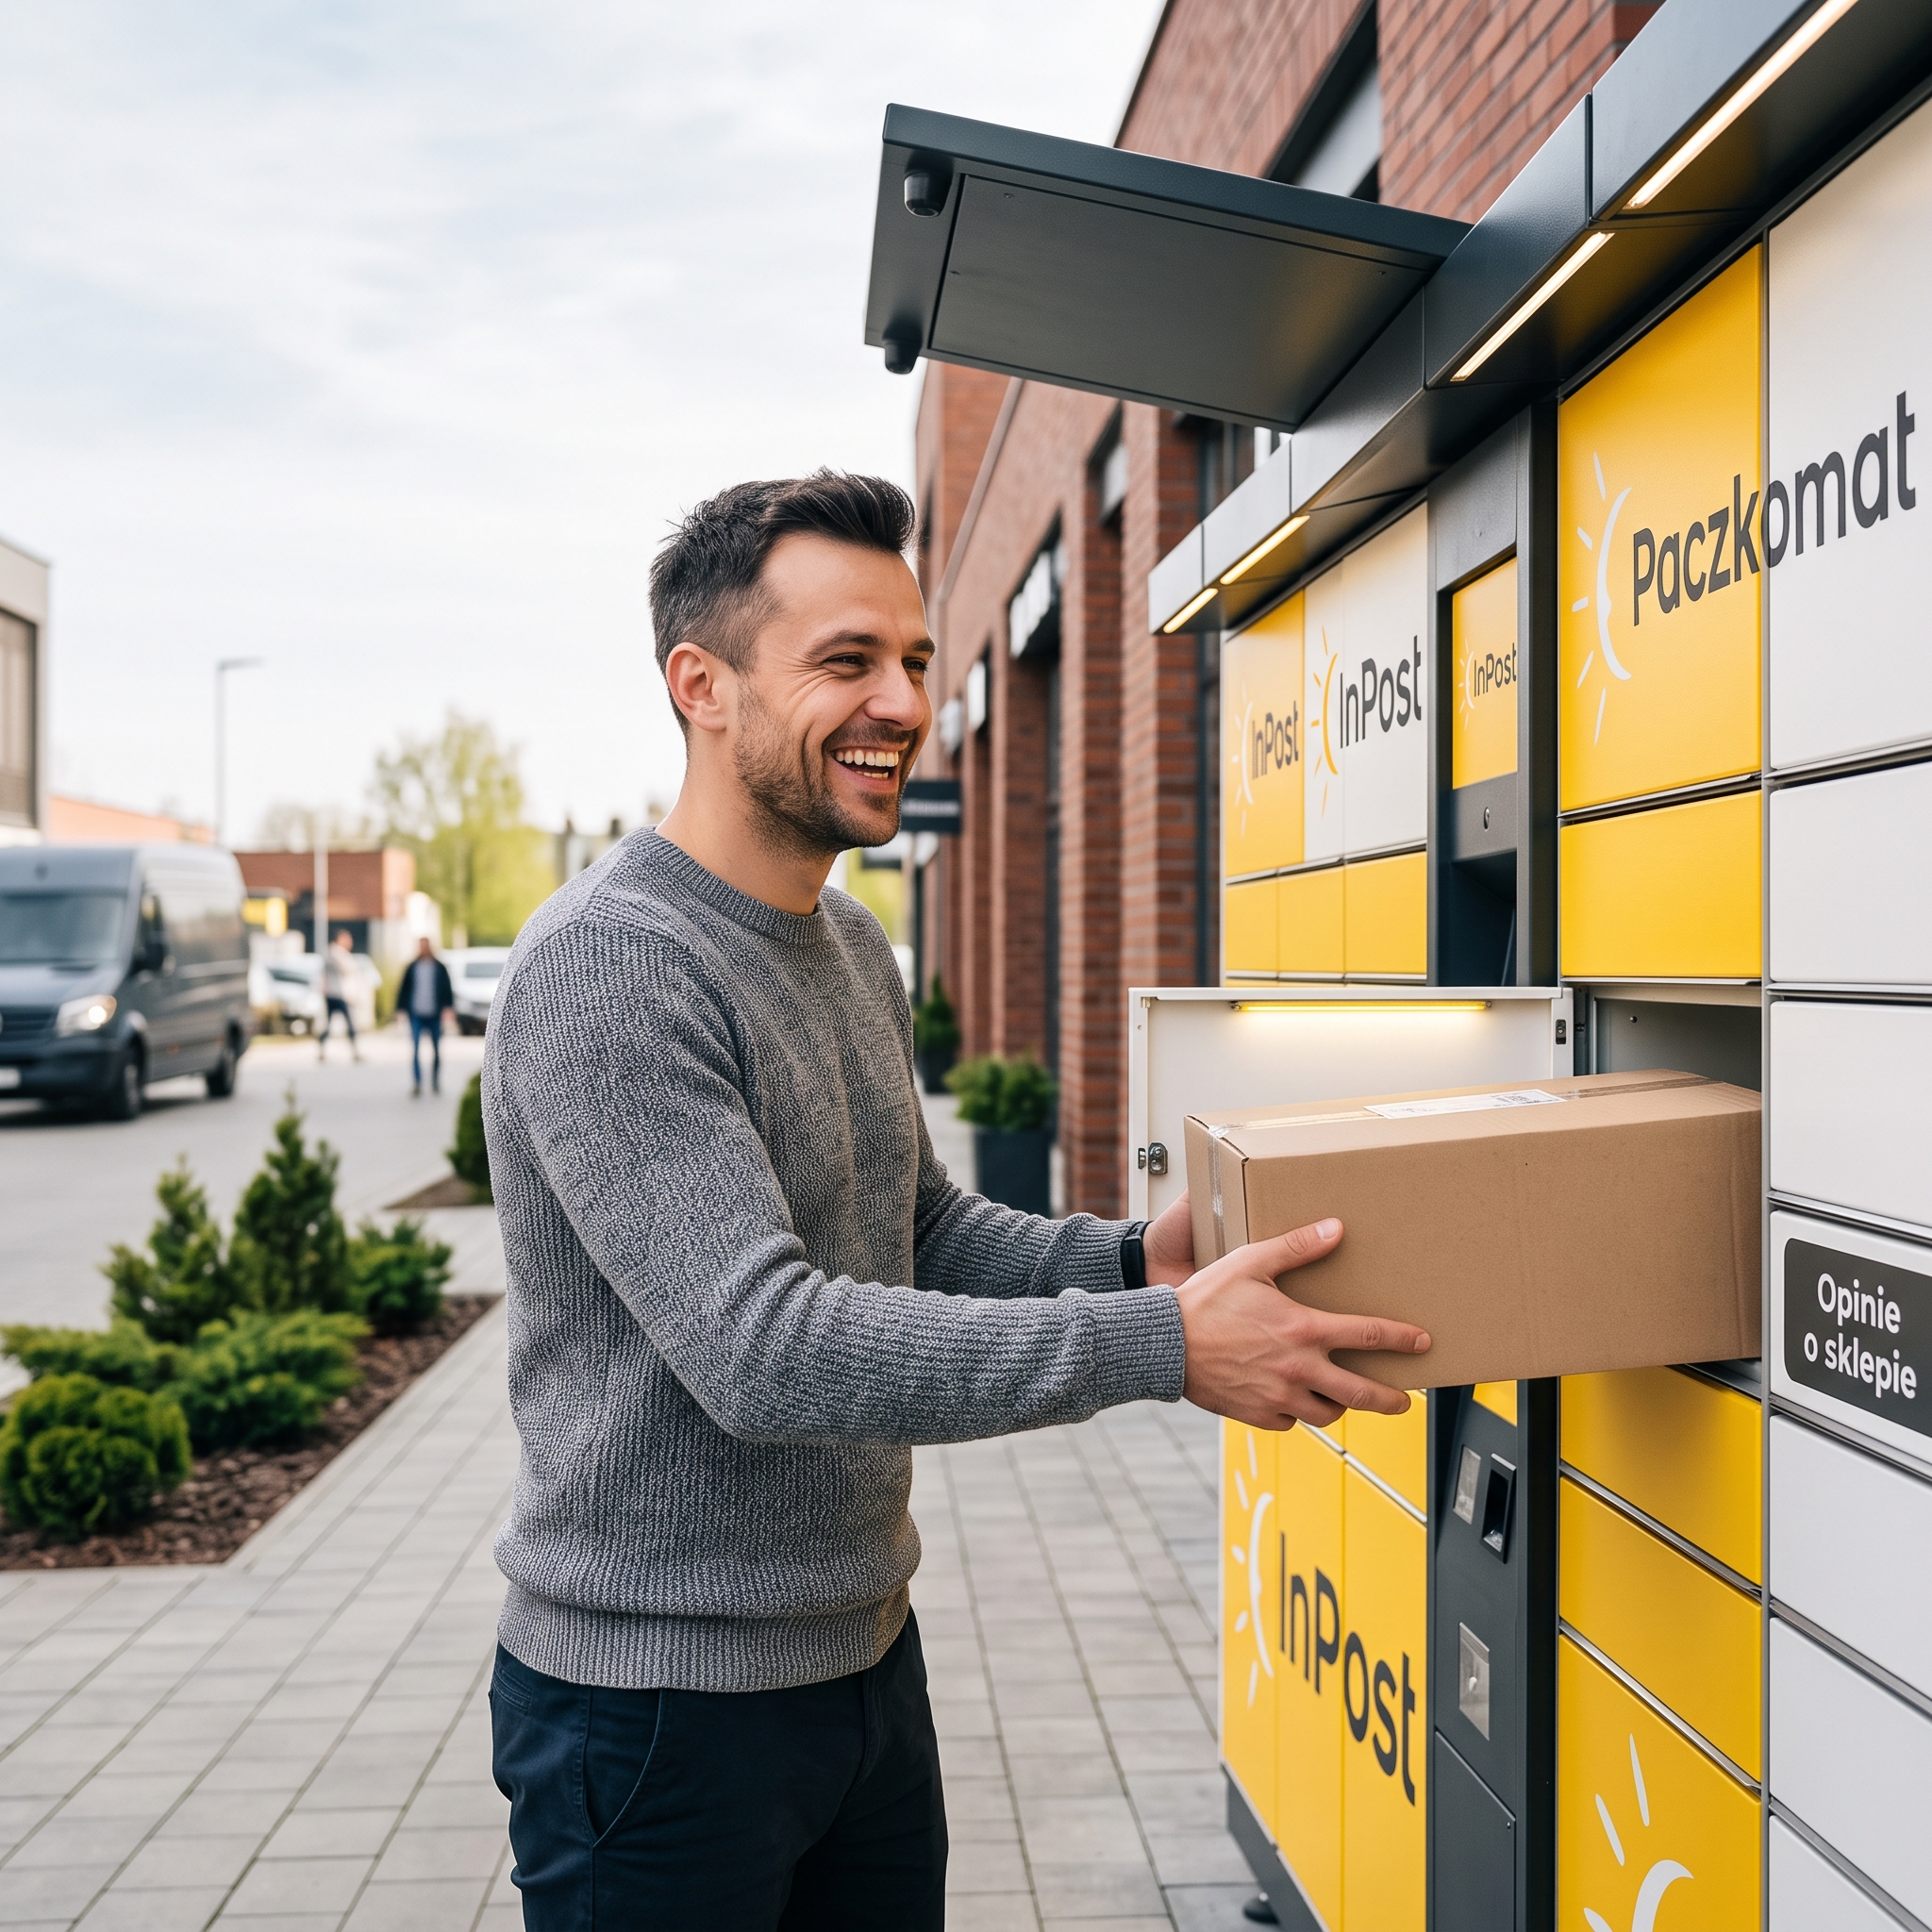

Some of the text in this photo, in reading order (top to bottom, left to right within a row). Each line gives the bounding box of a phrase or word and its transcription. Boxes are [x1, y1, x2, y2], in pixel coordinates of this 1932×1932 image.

[1633, 390, 1916, 627] Paczkomat
[1340, 635, 1422, 749] InPost
[1474, 641, 1517, 697] InPost
[1252, 700, 1299, 780] InPost
[1817, 1273, 1902, 1334] Opinie
[1804, 1332, 1918, 1400] o sklepie
[1280, 1530, 1416, 1807] InPost
